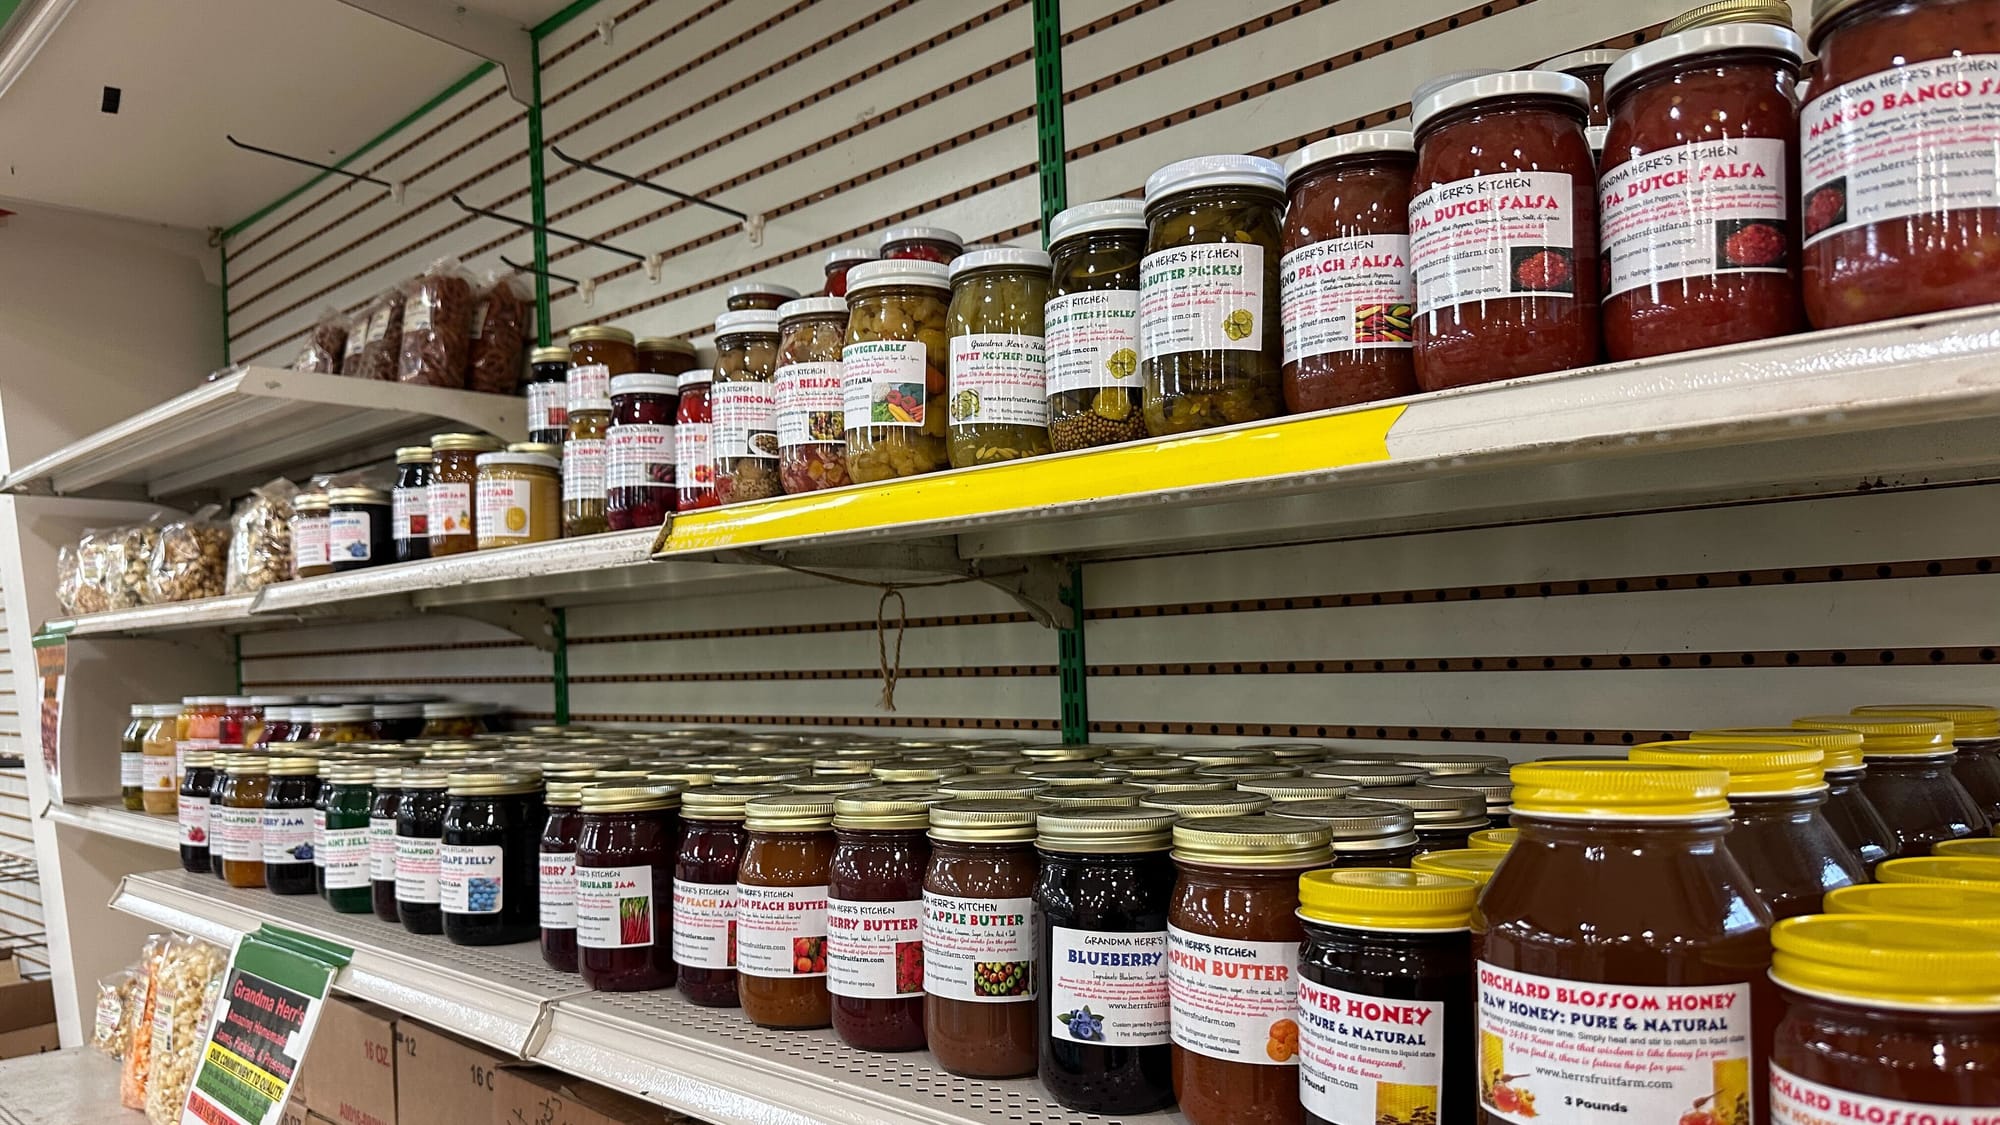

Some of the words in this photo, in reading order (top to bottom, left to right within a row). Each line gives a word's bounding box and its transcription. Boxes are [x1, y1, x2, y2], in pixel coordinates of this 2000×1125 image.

[1936, 60, 1997, 77] KITCHEN
[1882, 81, 1971, 109] BANGO
[1632, 154, 1673, 175] HERR'S
[1434, 198, 1494, 223] DUTCH
[1498, 195, 1559, 211] SALSA
[1296, 247, 1324, 261] HERR'S
[1327, 240, 1374, 254] KITCHEN
[1148, 267, 1186, 288] BUTTER
[1188, 264, 1243, 277] PICKLES
[1298, 258, 1345, 280] PEACH
[1350, 254, 1405, 270] SALSA
[1072, 296, 1109, 307] KITCHEN
[1096, 310, 1136, 319] PICKLES
[854, 344, 907, 355] VEGETABLES
[971, 339, 1003, 350] Grandma
[1005, 339, 1029, 349] Herr's
[799, 378, 840, 388] RELISH
[854, 376, 872, 386] FARM
[281, 818, 304, 826] JAM
[346, 837, 369, 847] JELL
[465, 856, 496, 865] JELLY
[614, 881, 636, 889] JAM
[699, 888, 730, 896] KITCHEN
[763, 890, 794, 898] KITCHEN
[686, 898, 716, 908] PEACH
[751, 900, 785, 911] PEACH
[837, 905, 858, 914] HERR'S
[860, 906, 895, 915] KITCHEN
[930, 897, 956, 909] HERR'S
[958, 902, 998, 912] KITCHEN
[863, 918, 918, 931] BUTTER
[932, 909, 966, 924] APPLE
[970, 914, 1024, 926] BUTTER
[1085, 936, 1132, 946] GRANDMA
[1134, 936, 1163, 946] HERR'S
[1184, 939, 1211, 953] HERR'S
[1214, 946, 1257, 958] KITCHEN
[1068, 949, 1162, 967] BLUEBERRY
[1212, 960, 1289, 982] BUTTER
[1481, 969, 1551, 1000] ORCHARD
[1556, 987, 1660, 1011] BLOSSOM
[1666, 992, 1737, 1011] HONEY
[233, 979, 276, 1011] Grandma
[275, 997, 306, 1026] Herr's
[1346, 998, 1433, 1026] HONEY
[1483, 992, 1505, 1009] RAW
[1509, 1000, 1565, 1023] HONEY:
[1570, 1012, 1618, 1030] PURE
[1623, 1017, 1638, 1031] &
[1643, 1017, 1728, 1032] NATURAL
[228, 1009, 253, 1033] Amazing
[1309, 1012, 1335, 1032] PURE
[1338, 1023, 1349, 1035] &
[1352, 1026, 1426, 1046] NATURAL
[215, 1028, 233, 1047] Jams,
[256, 1049, 263, 1062] &
[405, 1035, 417, 1057] 12
[1539, 1027, 1555, 1036] over
[1556, 1029, 1575, 1038] time.
[1577, 1031, 1606, 1044] Simply
[1608, 1036, 1627, 1044] heat
[1630, 1037, 1646, 1045] and
[1648, 1037, 1662, 1045] stir
[1673, 1038, 1698, 1046] return
[1708, 1036, 1728, 1046] liquid
[1316, 1044, 1335, 1055] words
[1357, 1054, 1406, 1070] honeycomb,
[1337, 1039, 1348, 1048] and
[1348, 1041, 1359, 1050] stir
[1367, 1046, 1390, 1055] return
[1399, 1049, 1419, 1058] liquid
[1531, 1035, 1555, 1047] Know
[1555, 1040, 1575, 1050] also
[1577, 1042, 1595, 1053] that
[1597, 1046, 1634, 1057] wisdom
[1647, 1048, 1664, 1058] like
[1666, 1049, 1693, 1060] honey
[1695, 1049, 1709, 1059] for
[210, 1048, 221, 1062] OUR
[221, 1054, 252, 1081] COMMITMENT
[251, 1072, 260, 1085] TO
[1508, 1043, 1516, 1052] if
[1516, 1046, 1529, 1055] you
[1530, 1047, 1547, 1058] find
[1558, 1054, 1579, 1064] there
[1582, 1056, 1590, 1065] is
[1592, 1056, 1622, 1070] future
[1624, 1058, 1647, 1072] hope
[1648, 1060, 1664, 1073] for
[470, 1064, 484, 1087] 16
[1338, 1063, 1345, 1071] to
[1347, 1066, 1359, 1075] the
[1360, 1068, 1383, 1079] bones
[1535, 1065, 1673, 1090] www.herrsfruitfarm.com
[1304, 1075, 1326, 1094] Pound
[1564, 1095, 1573, 1106] 3
[1575, 1098, 1629, 1113] Pounds
